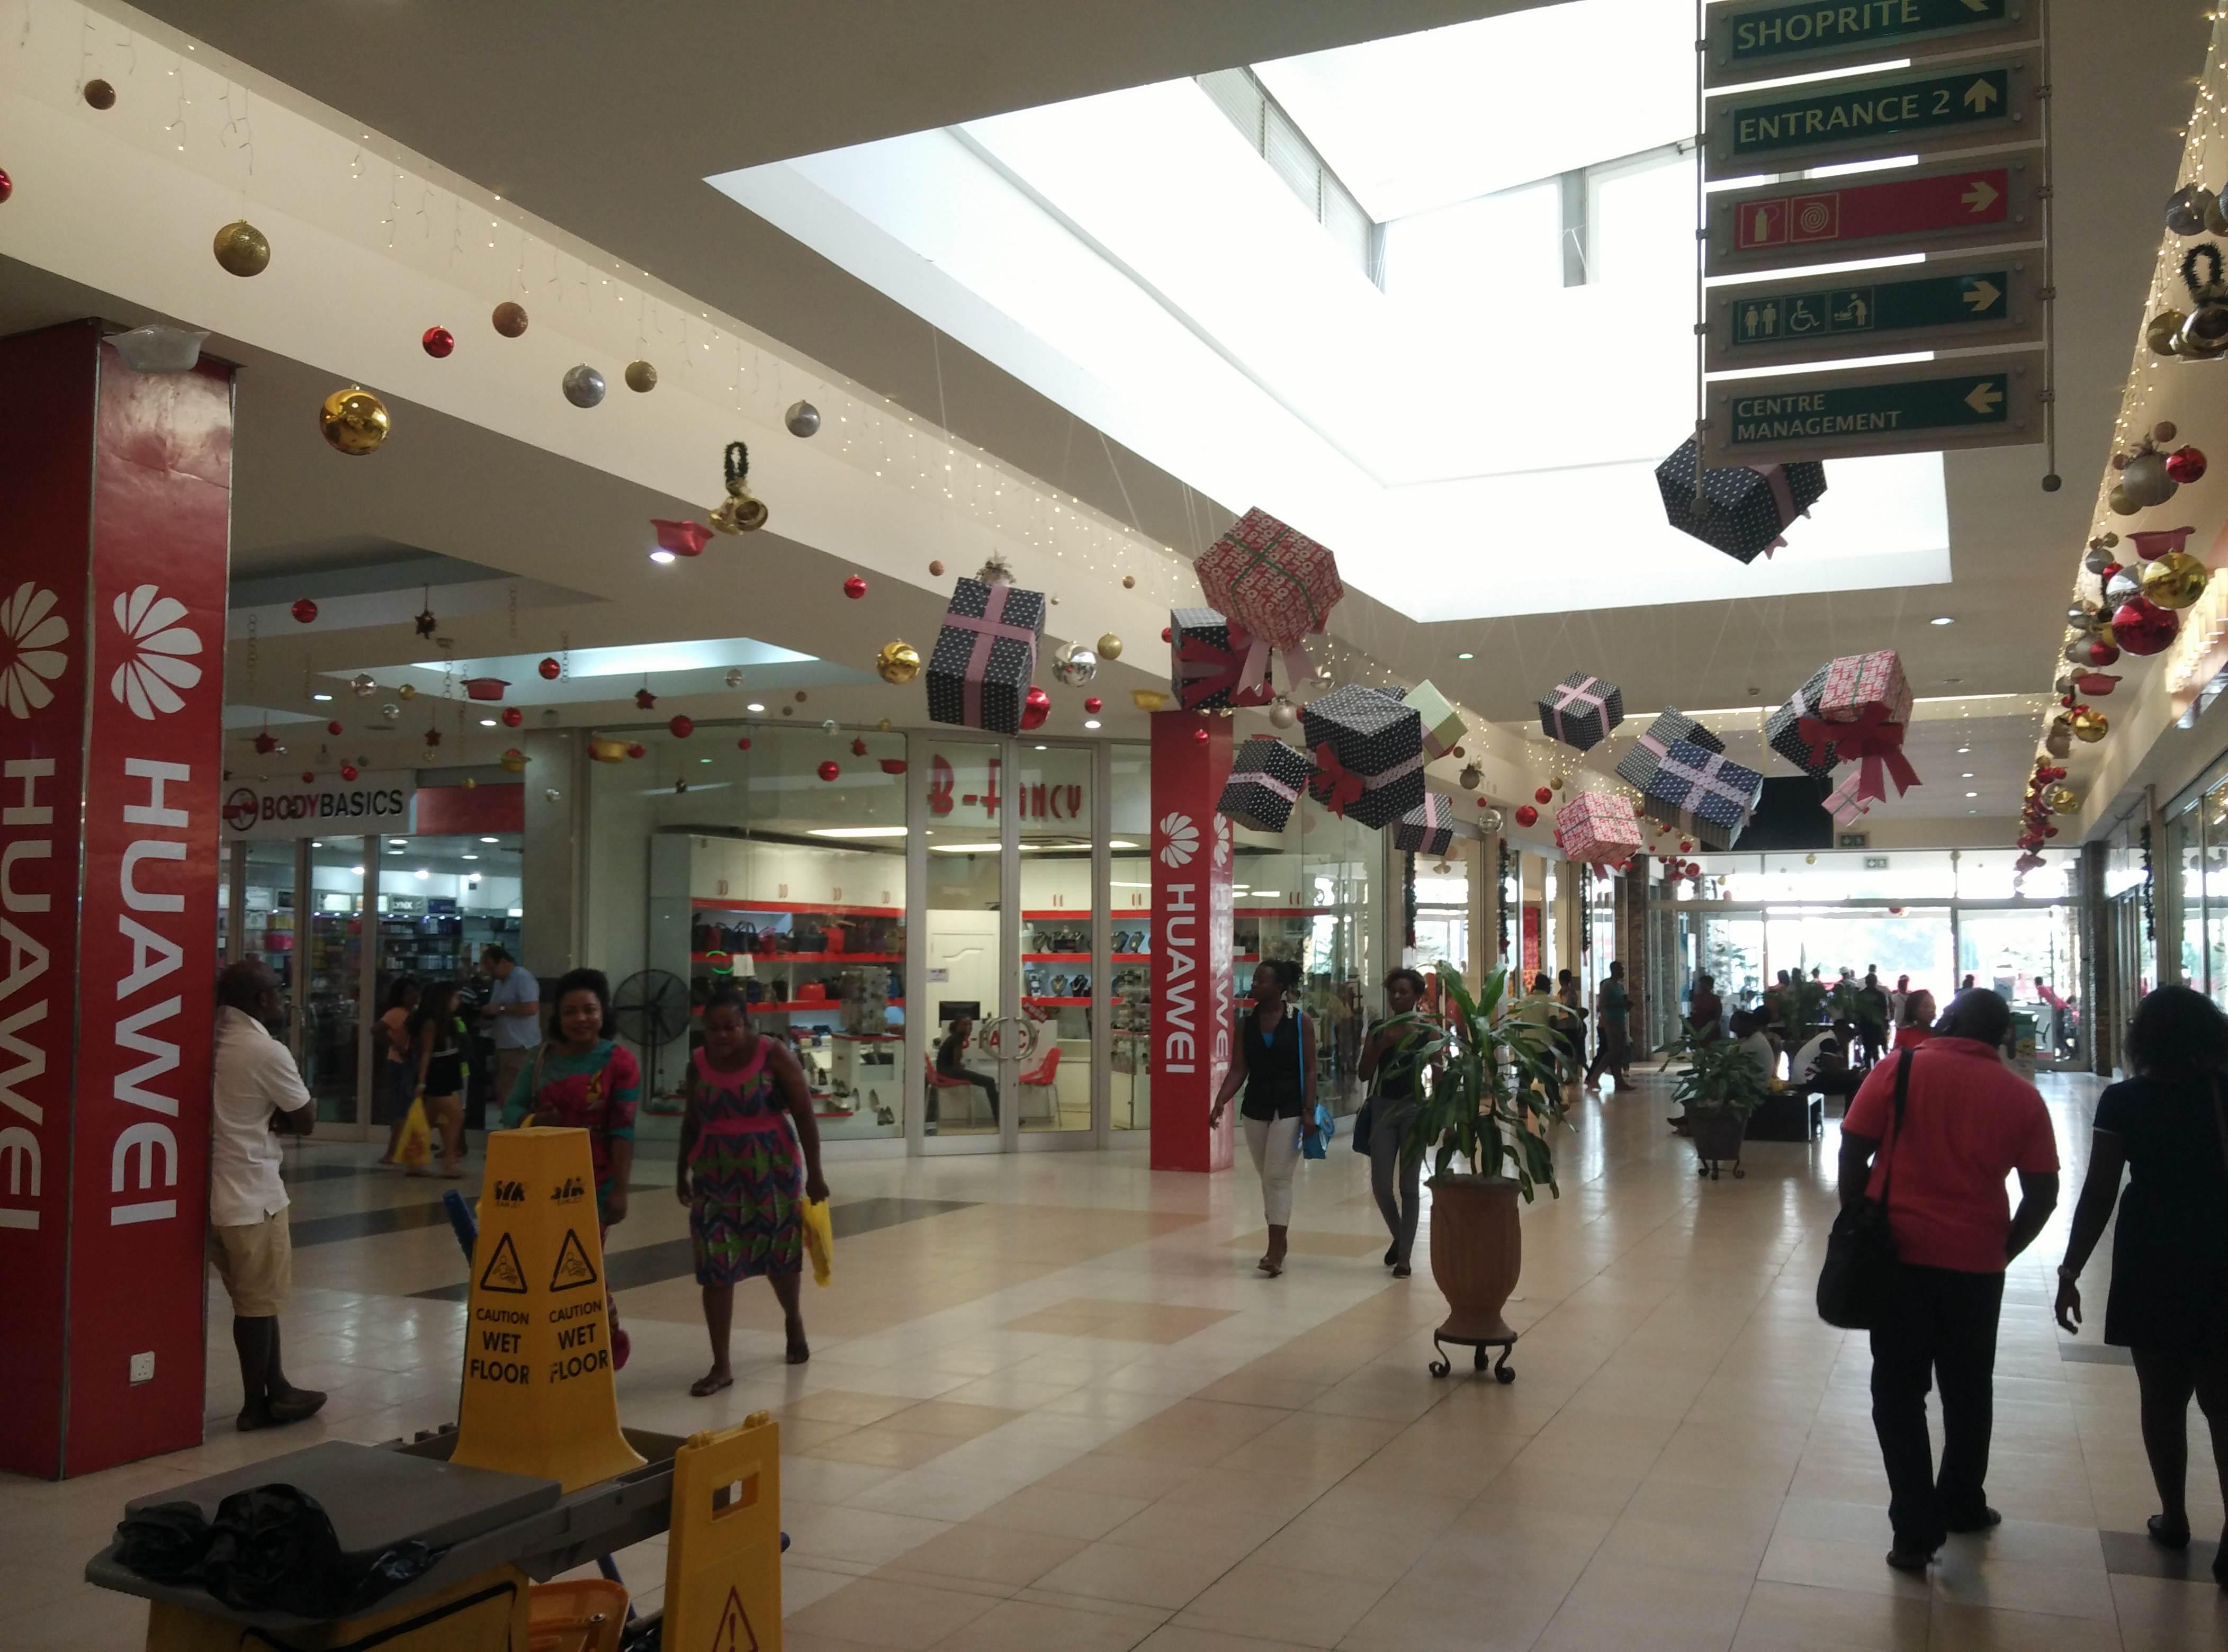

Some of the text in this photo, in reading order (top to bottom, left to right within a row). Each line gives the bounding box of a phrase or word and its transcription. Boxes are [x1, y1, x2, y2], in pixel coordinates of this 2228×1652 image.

[1737, 0, 1920, 49] SHOPRITE
[1740, 89, 1950, 142] ENTRANCE 2
[1738, 394, 1826, 417] CENTRE
[1738, 411, 1902, 440] MANAGEMENT
[110, 757, 190, 1226] HUAWEI
[1166, 883, 1195, 1073] HUAWEI
[0, 758, 56, 1231] HUAWEI
[476, 1308, 529, 1324] CAUTION
[550, 1300, 602, 1323] CAUTION
[483, 1331, 521, 1353] WET
[558, 1323, 596, 1350] WET
[471, 1359, 529, 1385] FLOOR
[550, 1350, 608, 1384] FLOOR
